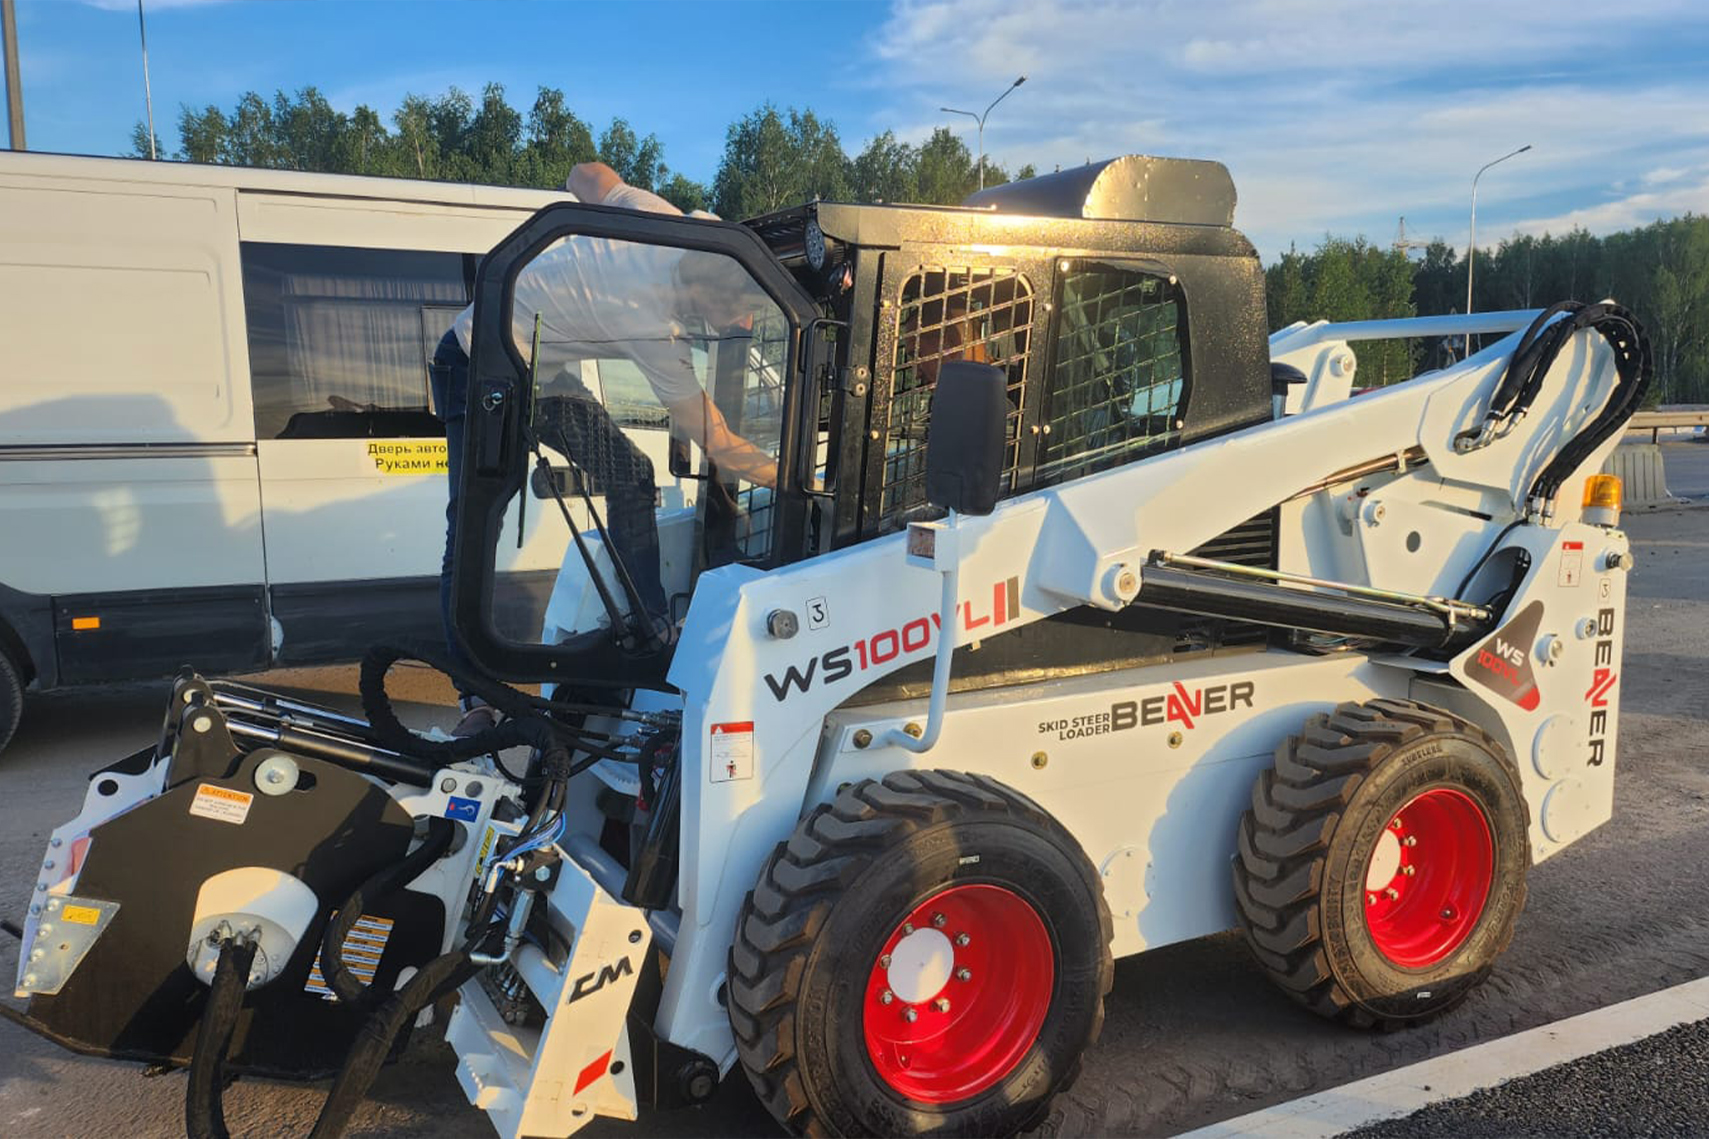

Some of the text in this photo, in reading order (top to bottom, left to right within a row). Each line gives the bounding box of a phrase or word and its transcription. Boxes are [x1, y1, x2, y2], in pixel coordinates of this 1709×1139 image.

[368, 443, 447, 456] Дверь авто
[375, 458, 431, 472] Руками
[1496, 637, 1525, 668] WS
[1584, 607, 1617, 767] BEAVER
[1111, 681, 1255, 732] BEAVER
[1038, 712, 1111, 734] SKID STEER
[1059, 723, 1111, 741] LOADER
